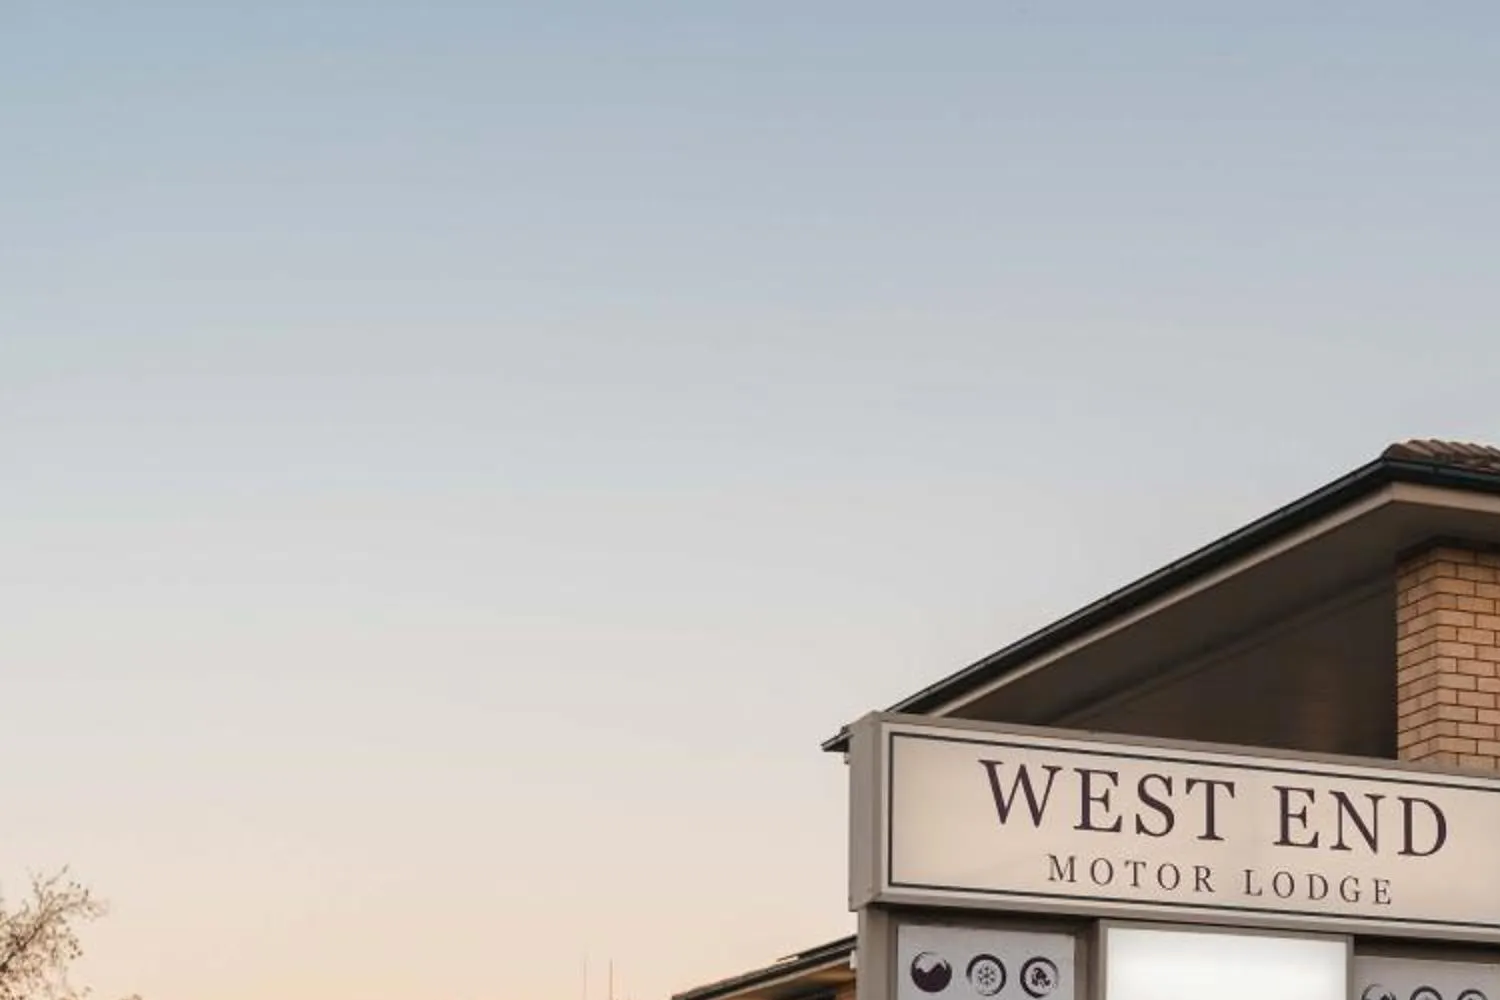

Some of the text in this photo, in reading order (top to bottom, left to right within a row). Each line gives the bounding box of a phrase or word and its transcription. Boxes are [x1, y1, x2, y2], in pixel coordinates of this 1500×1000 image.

[977, 758, 1449, 857] WEST END
[1047, 853, 1393, 905] MOTOR LODGE
